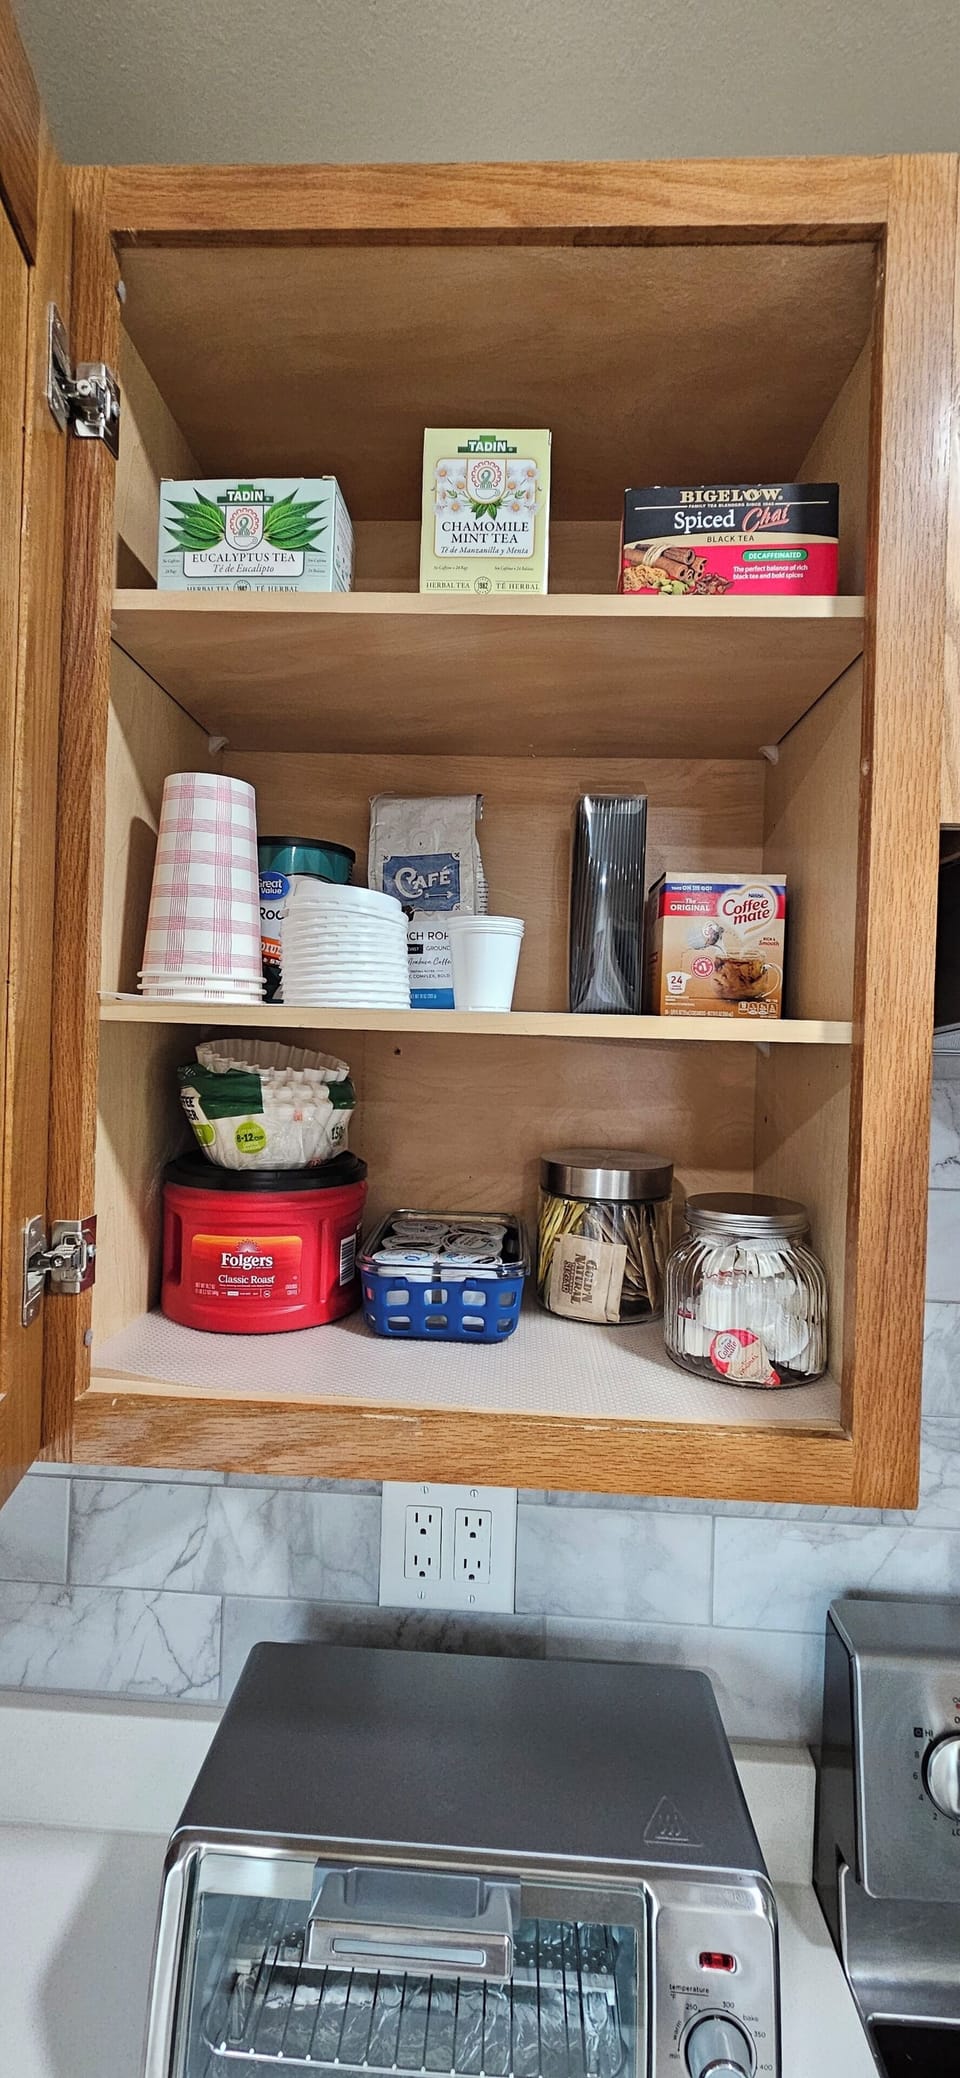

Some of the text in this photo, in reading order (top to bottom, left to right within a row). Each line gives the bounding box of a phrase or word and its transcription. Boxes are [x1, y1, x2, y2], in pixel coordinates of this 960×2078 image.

[469, 441, 507, 451] TADIN
[227, 491, 264, 501] TADIN
[680, 488, 782, 503] BIGELOW
[674, 504, 791, 534] Spiced Chai
[442, 522, 529, 532] CHAMOMILE
[451, 533, 518, 543] MINT TEA
[192, 552, 296, 562] EUCALYPTUS TEA
[748, 552, 801, 560] DECAFFEINATED
[226, 564, 235, 572] de
[236, 563, 274, 574] Eucalipto
[395, 865, 451, 898] CAFÉ
[723, 899, 769, 916] Coffee
[734, 910, 770, 925] mate
[671, 976, 683, 984] 24
[221, 1253, 273, 1270] Folgers
[218, 1275, 275, 1284] Classic Roast
[570, 1254, 586, 1304] NATURAL
[669, 1984, 709, 1993] temperature
[673, 2020, 682, 2040] warm
